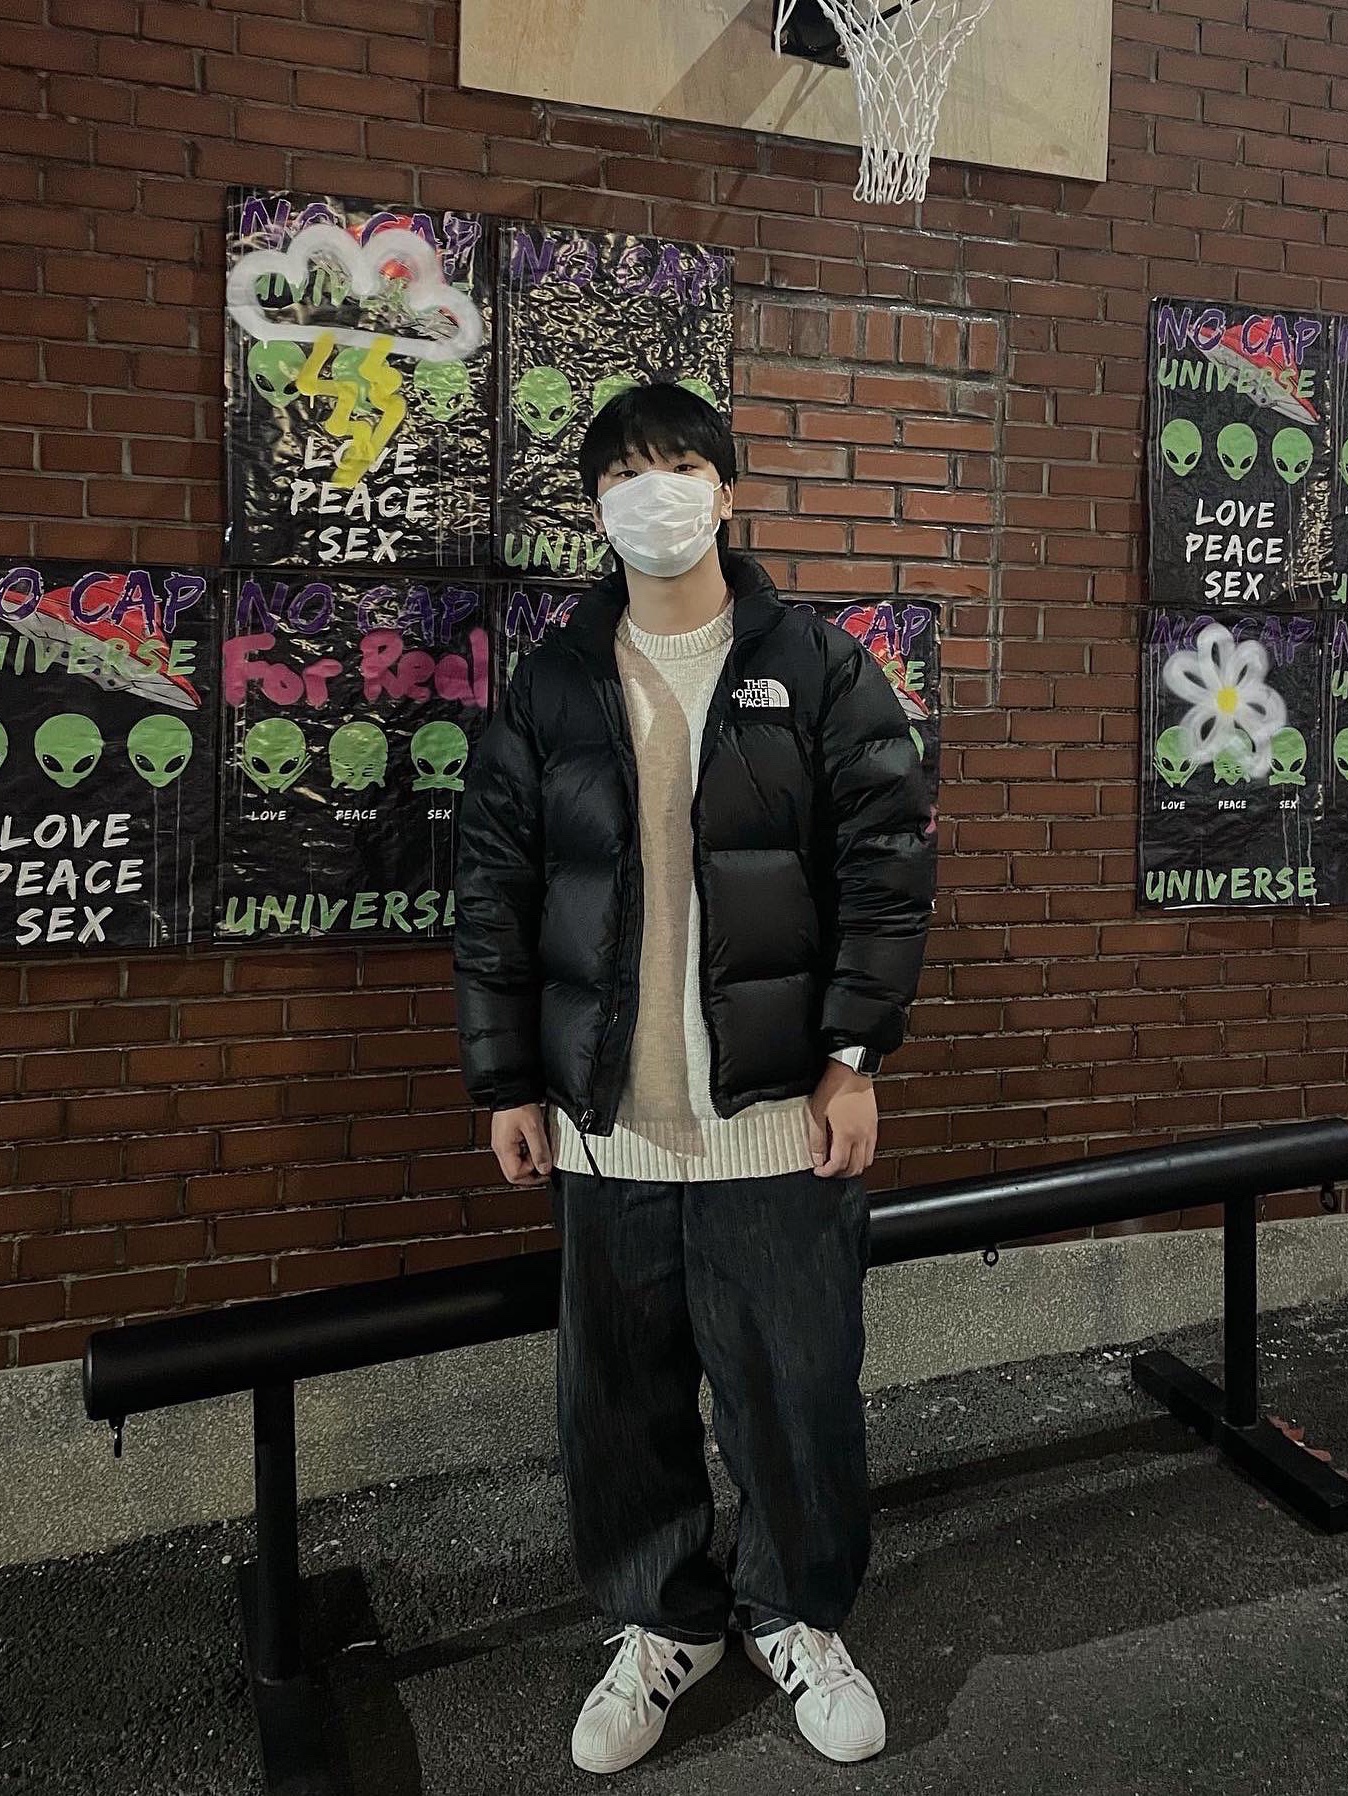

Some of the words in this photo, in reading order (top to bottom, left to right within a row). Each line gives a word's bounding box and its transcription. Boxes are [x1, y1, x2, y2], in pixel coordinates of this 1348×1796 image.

[1158, 305, 1226, 351] NO
[1241, 314, 1321, 365] CAP
[1158, 358, 1316, 398] UNIVERSE
[290, 479, 433, 522] PEACE
[1195, 498, 1275, 529] LOVE
[317, 526, 404, 563] SEX
[1185, 532, 1284, 567] PEACE
[70, 570, 206, 637] CAP
[1204, 570, 1265, 601] SEX
[236, 580, 335, 635] NO
[358, 584, 480, 648] CAP
[222, 632, 344, 709] For
[360, 627, 489, 709] Real
[744, 679, 768, 689] THE
[739, 698, 769, 708] FACE
[251, 809, 287, 822] LOVE
[335, 809, 378, 821] PEACE
[427, 809, 452, 821] SEX
[1160, 800, 1186, 811] LOVE
[1218, 800, 1247, 811] PEACE
[1279, 800, 1297, 810] SEX
[0, 813, 132, 852] LOVE
[1145, 866, 1317, 903] UNIVERSE
[15, 905, 114, 946] SEX
